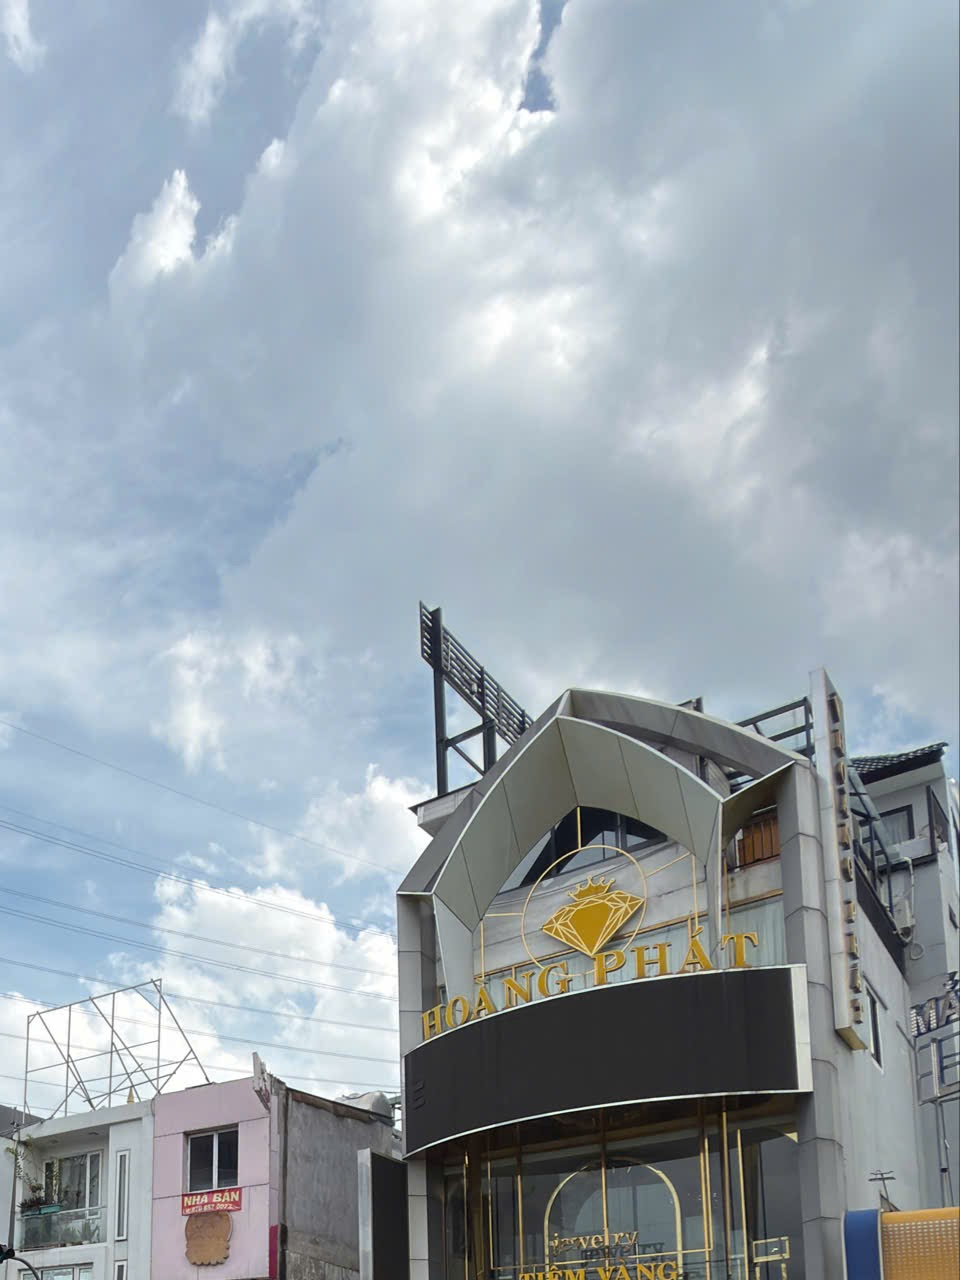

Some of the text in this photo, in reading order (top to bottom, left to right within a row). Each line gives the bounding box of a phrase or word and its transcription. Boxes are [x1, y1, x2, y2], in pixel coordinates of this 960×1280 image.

[420, 924, 759, 1041] HOÀNG PHÁT
[212, 1189, 240, 1203] BÁN
